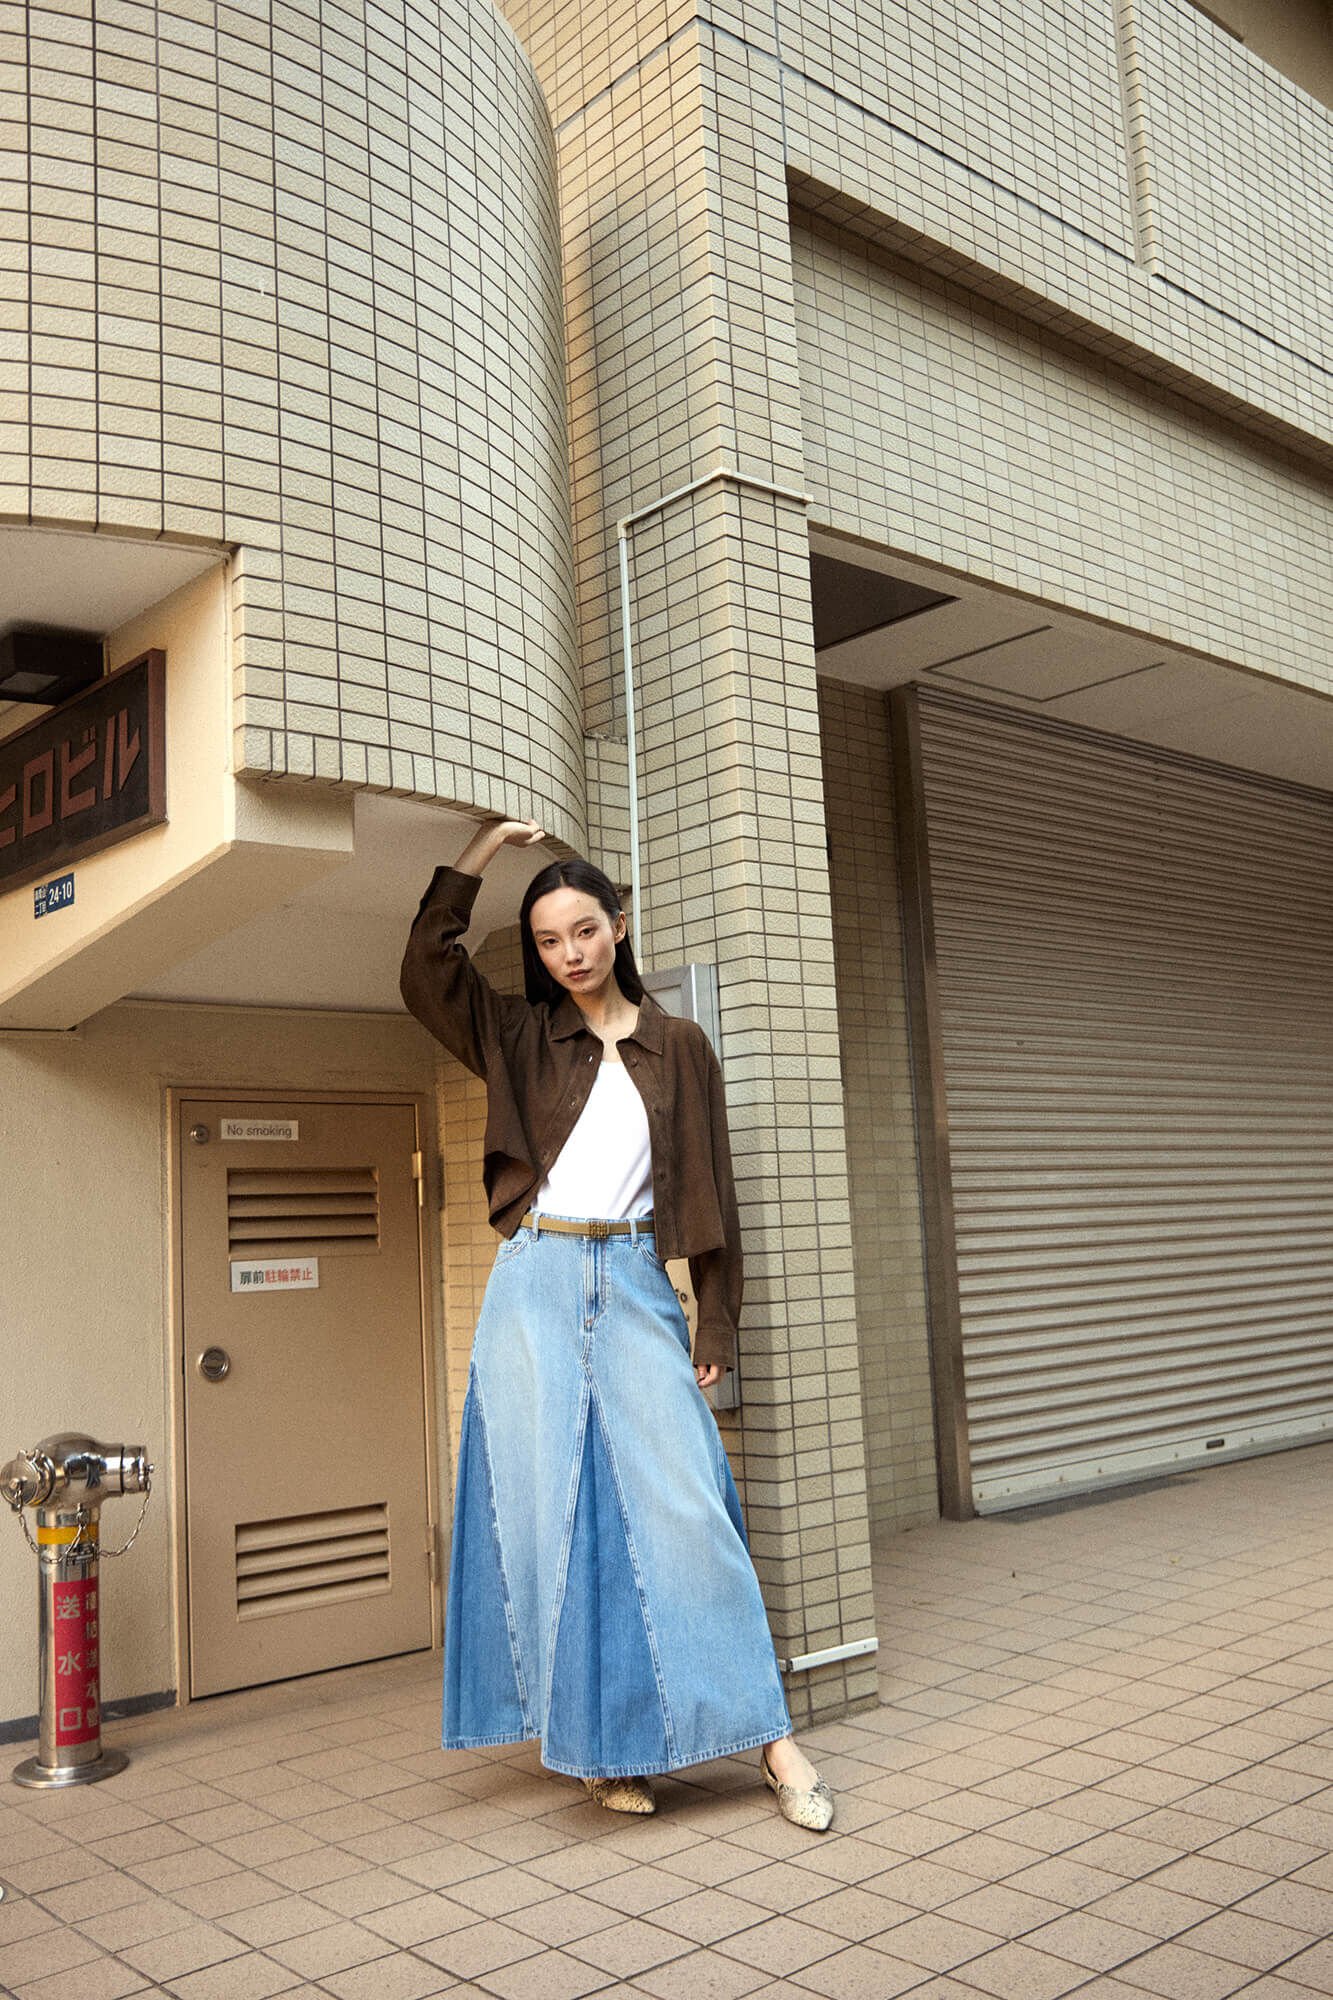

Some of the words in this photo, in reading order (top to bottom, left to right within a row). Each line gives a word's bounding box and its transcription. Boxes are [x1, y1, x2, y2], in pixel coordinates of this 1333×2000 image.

[227, 1124, 243, 1136] No
[246, 1126, 292, 1139] smoking
[56, 1593, 82, 1732] 送水口
